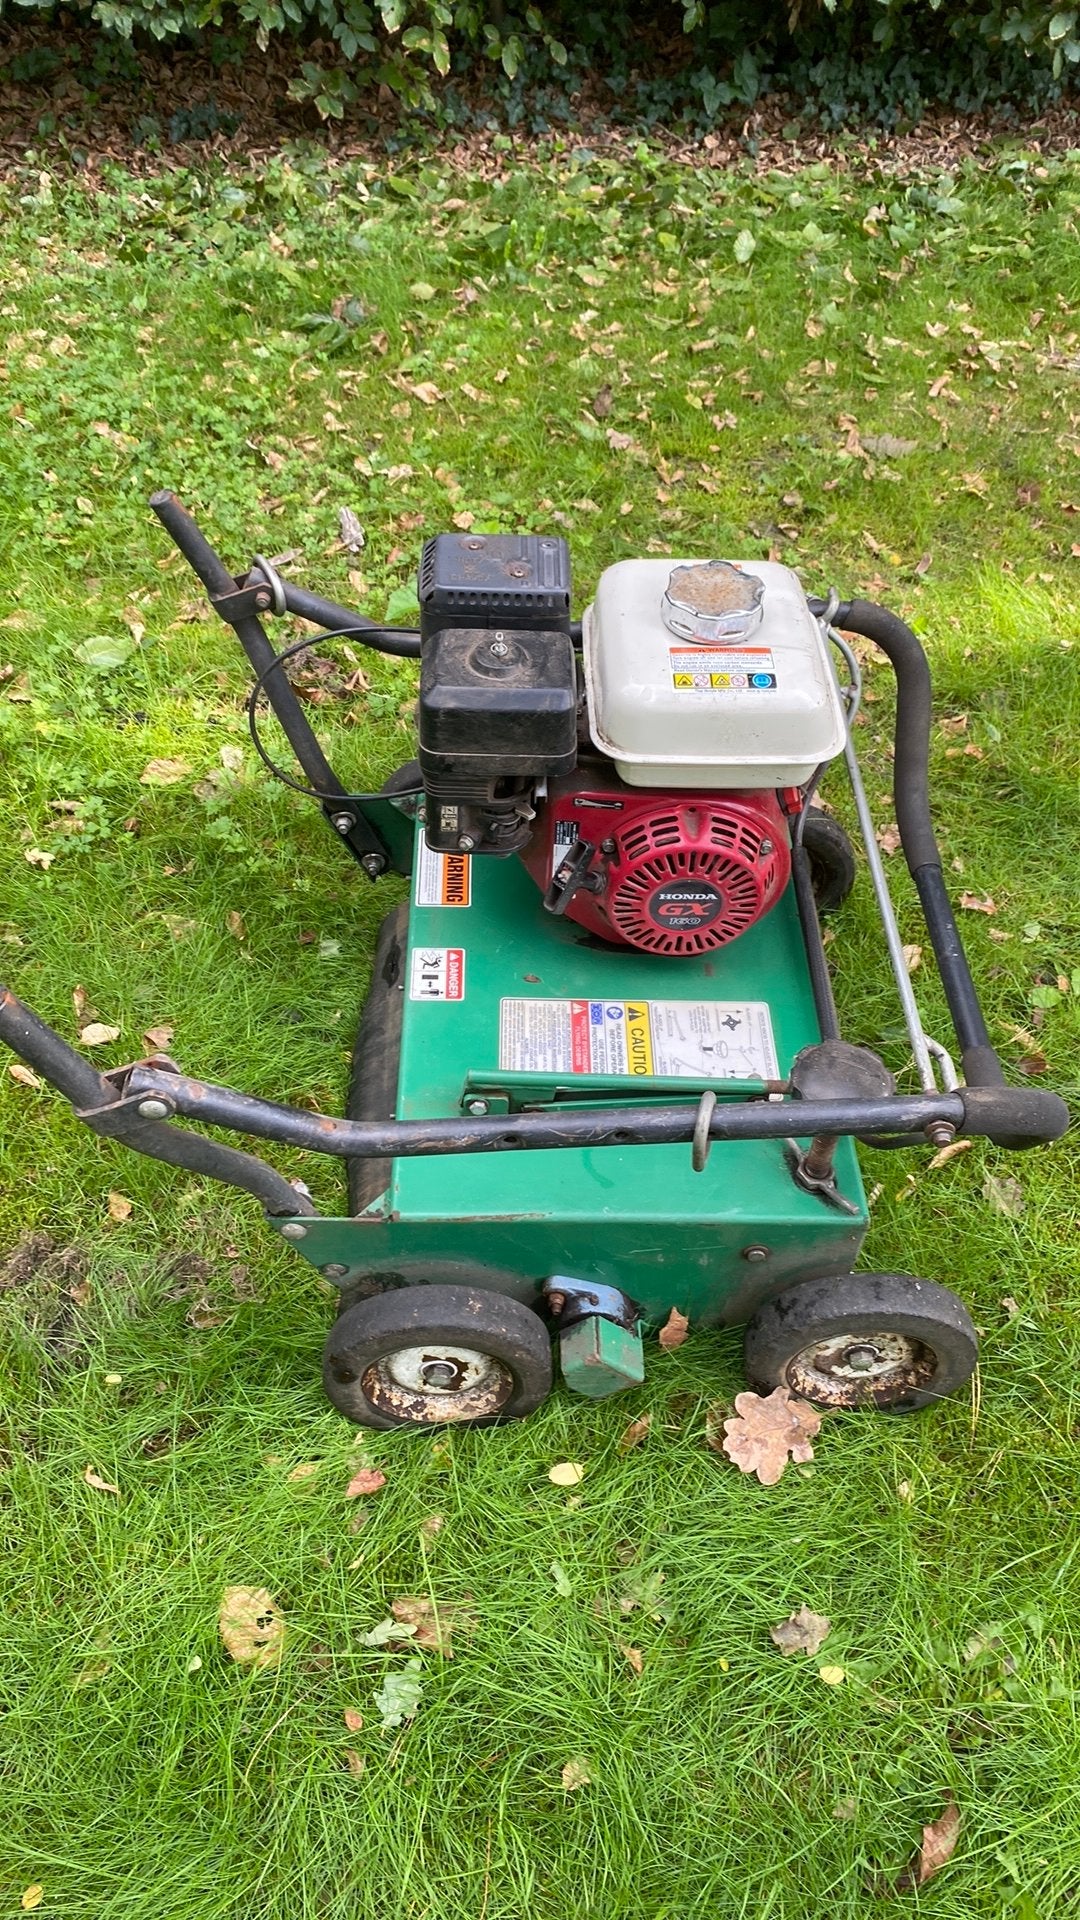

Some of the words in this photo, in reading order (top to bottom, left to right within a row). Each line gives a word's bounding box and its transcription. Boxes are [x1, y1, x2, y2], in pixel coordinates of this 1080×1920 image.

[658, 902, 714, 916] GX
[669, 917, 701, 925] 160
[448, 962, 460, 997] DANGER
[581, 1040, 589, 1073] BYSTANDER
[610, 1054, 618, 1075] OPERA
[631, 1028, 647, 1075] CAUTIO
